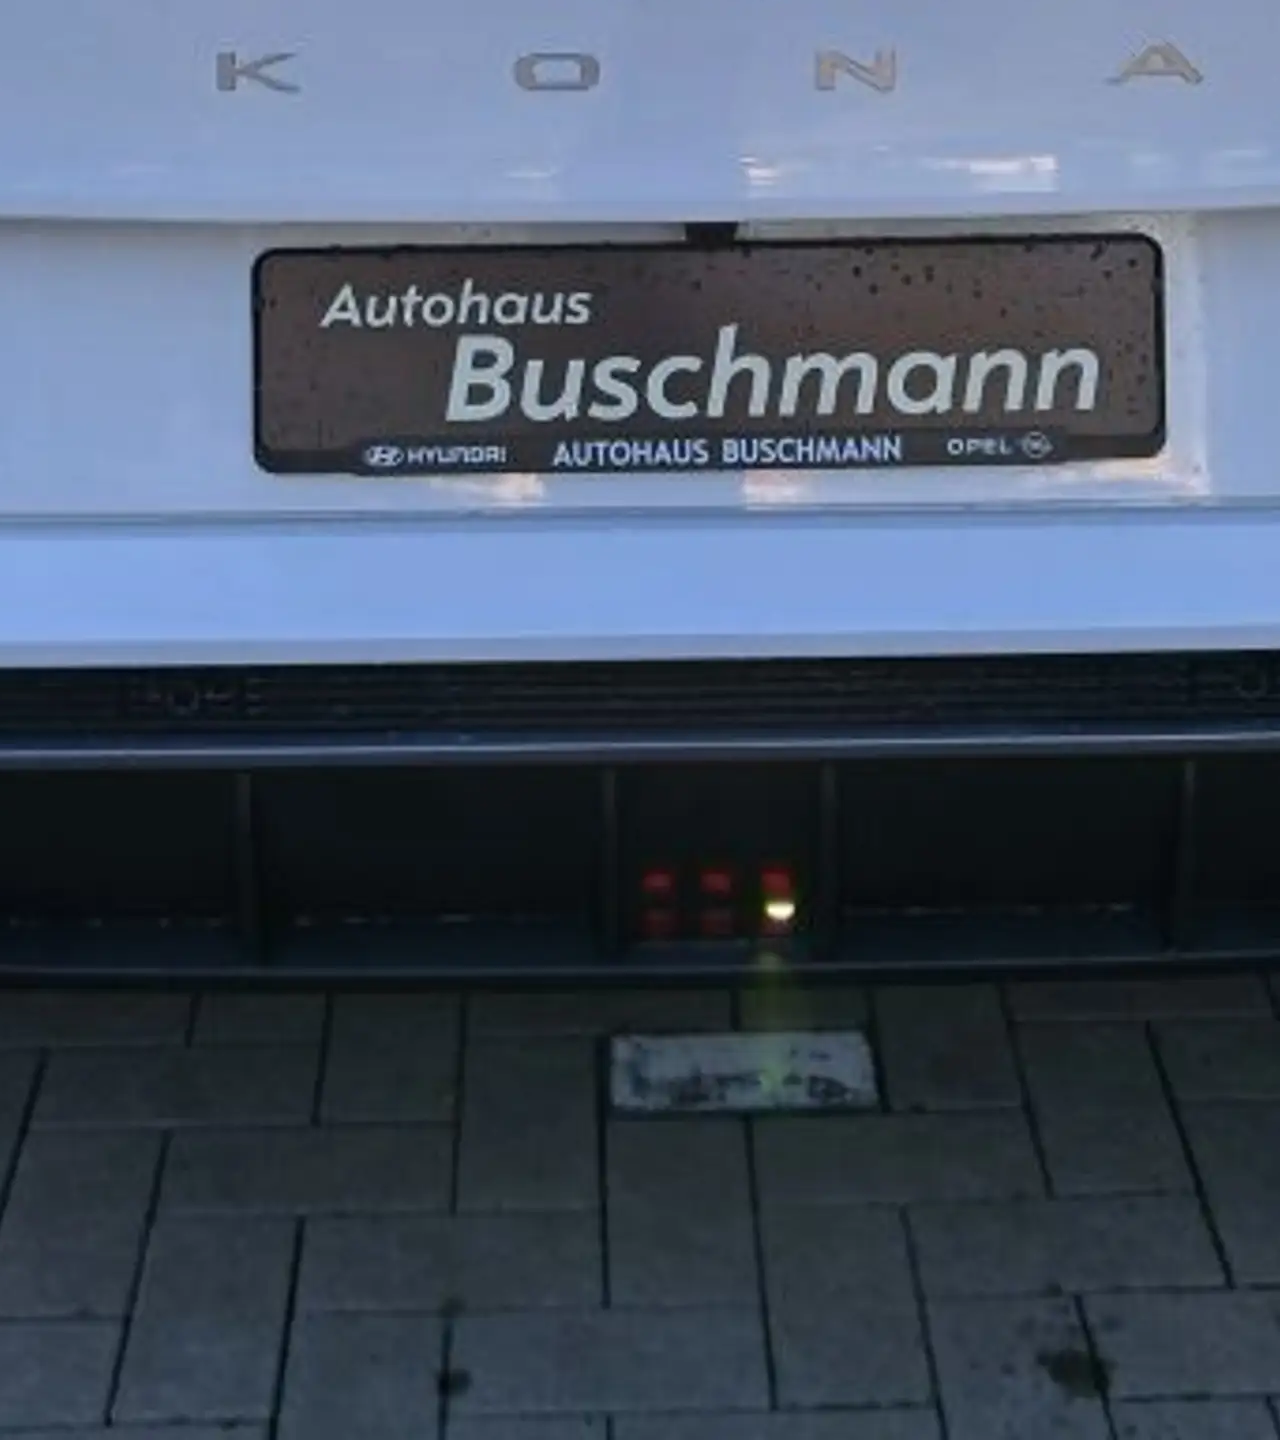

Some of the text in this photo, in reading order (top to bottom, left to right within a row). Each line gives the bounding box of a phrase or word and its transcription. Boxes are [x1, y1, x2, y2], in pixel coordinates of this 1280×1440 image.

[320, 277, 593, 328] Autohaus
[445, 324, 1100, 423] Buschmann
[407, 445, 507, 463] HYUNDAI
[553, 434, 902, 467] AUTOHAUS BUSCHMANN
[947, 438, 1014, 455] OPEL
